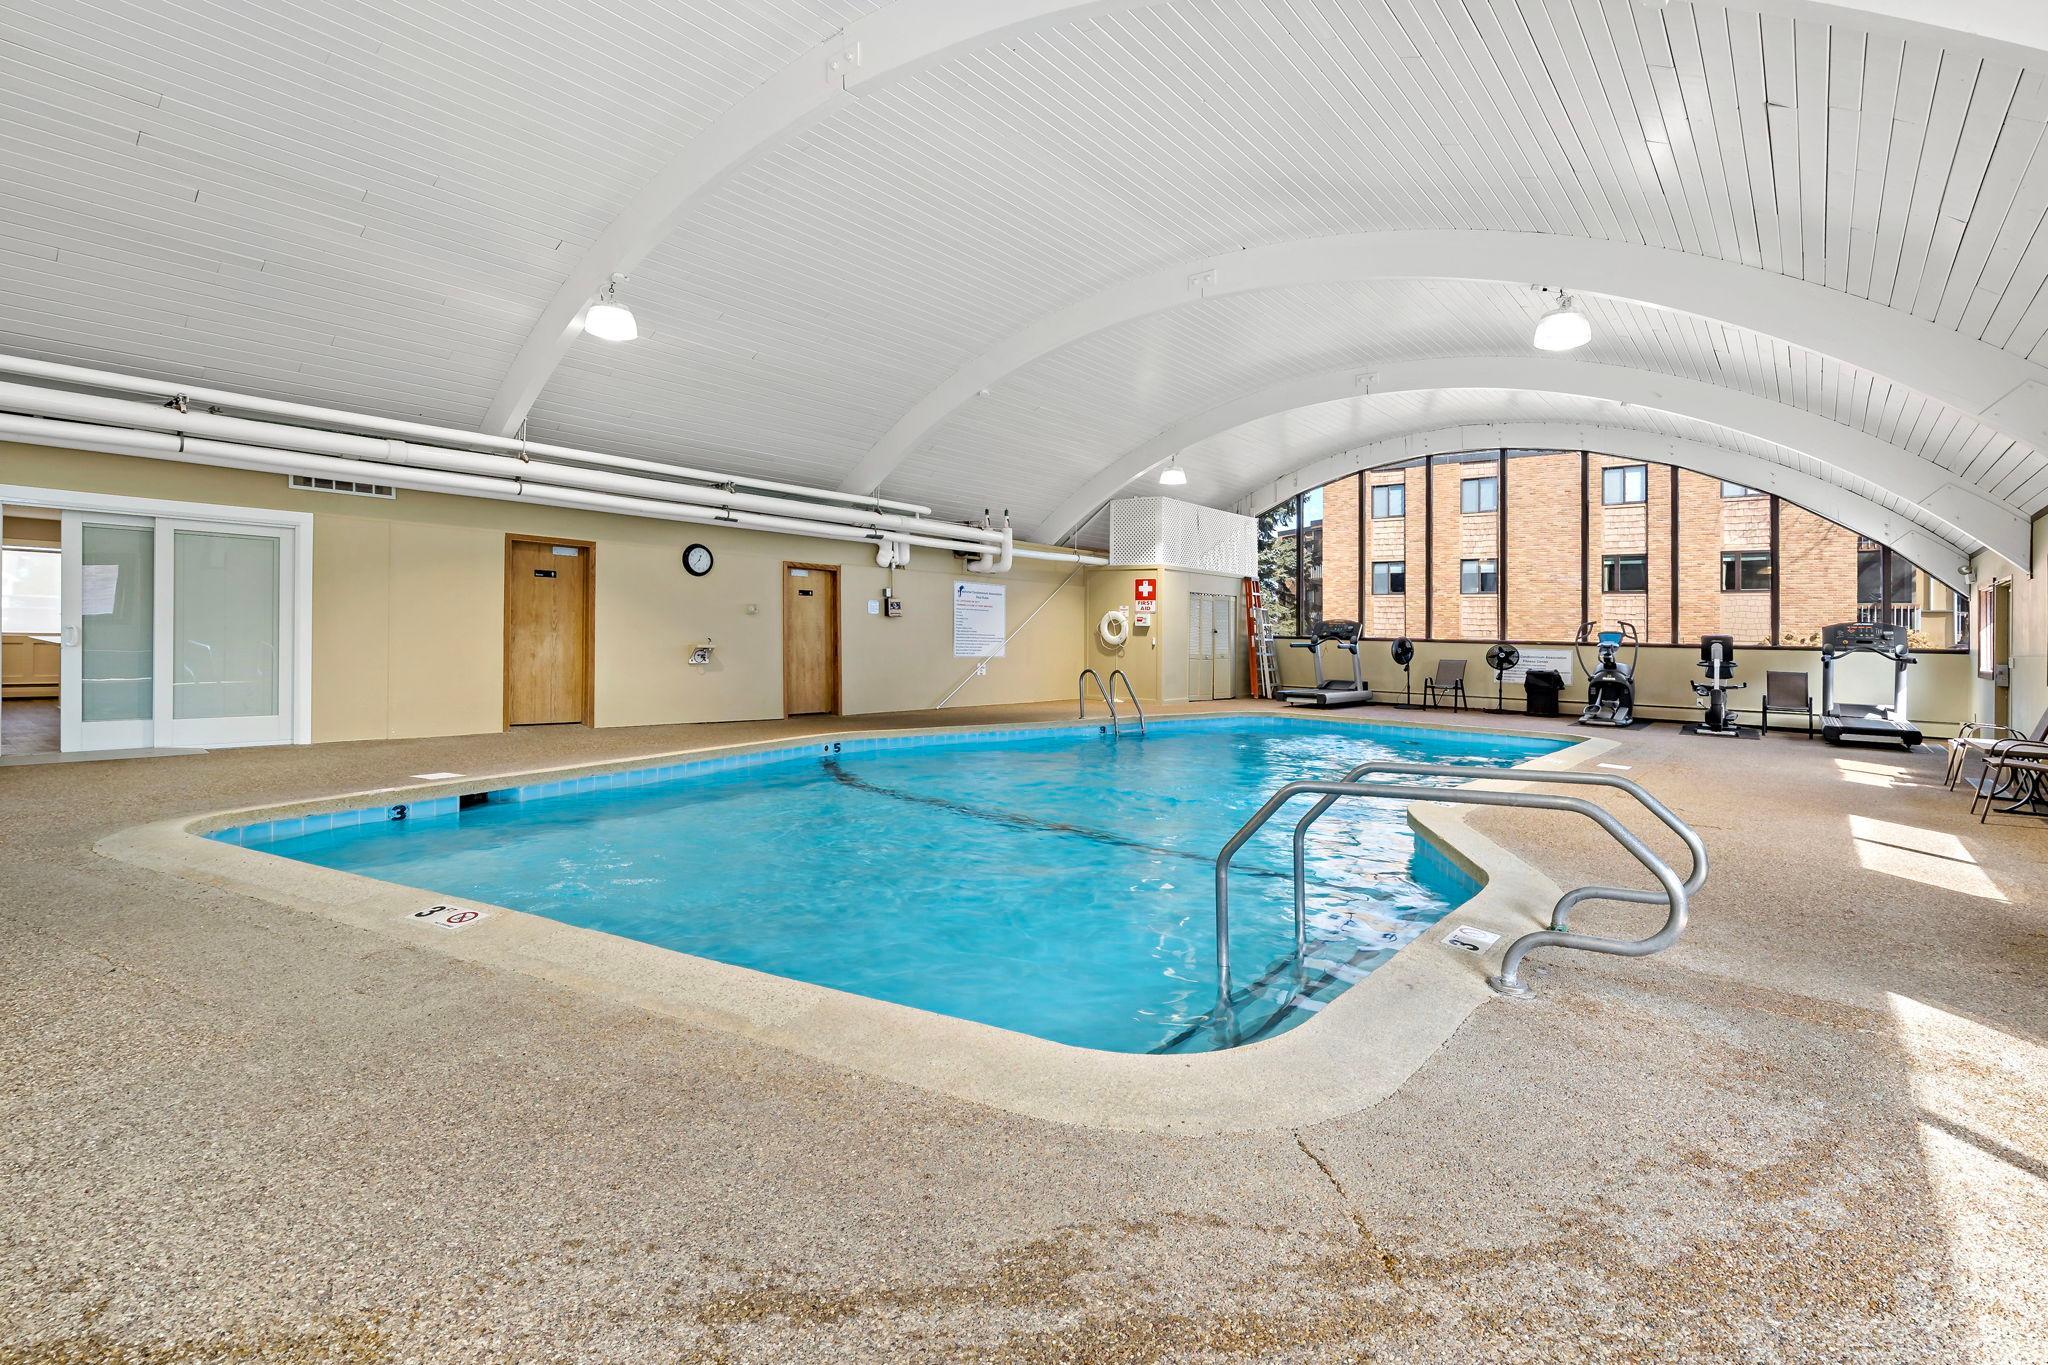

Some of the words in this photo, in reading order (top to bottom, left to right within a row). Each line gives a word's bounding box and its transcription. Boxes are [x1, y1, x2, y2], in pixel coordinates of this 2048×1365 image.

[833, 742, 841, 753] 5
[391, 804, 408, 821] 3
[414, 906, 446, 918] 3
[1449, 939, 1480, 951] 3
